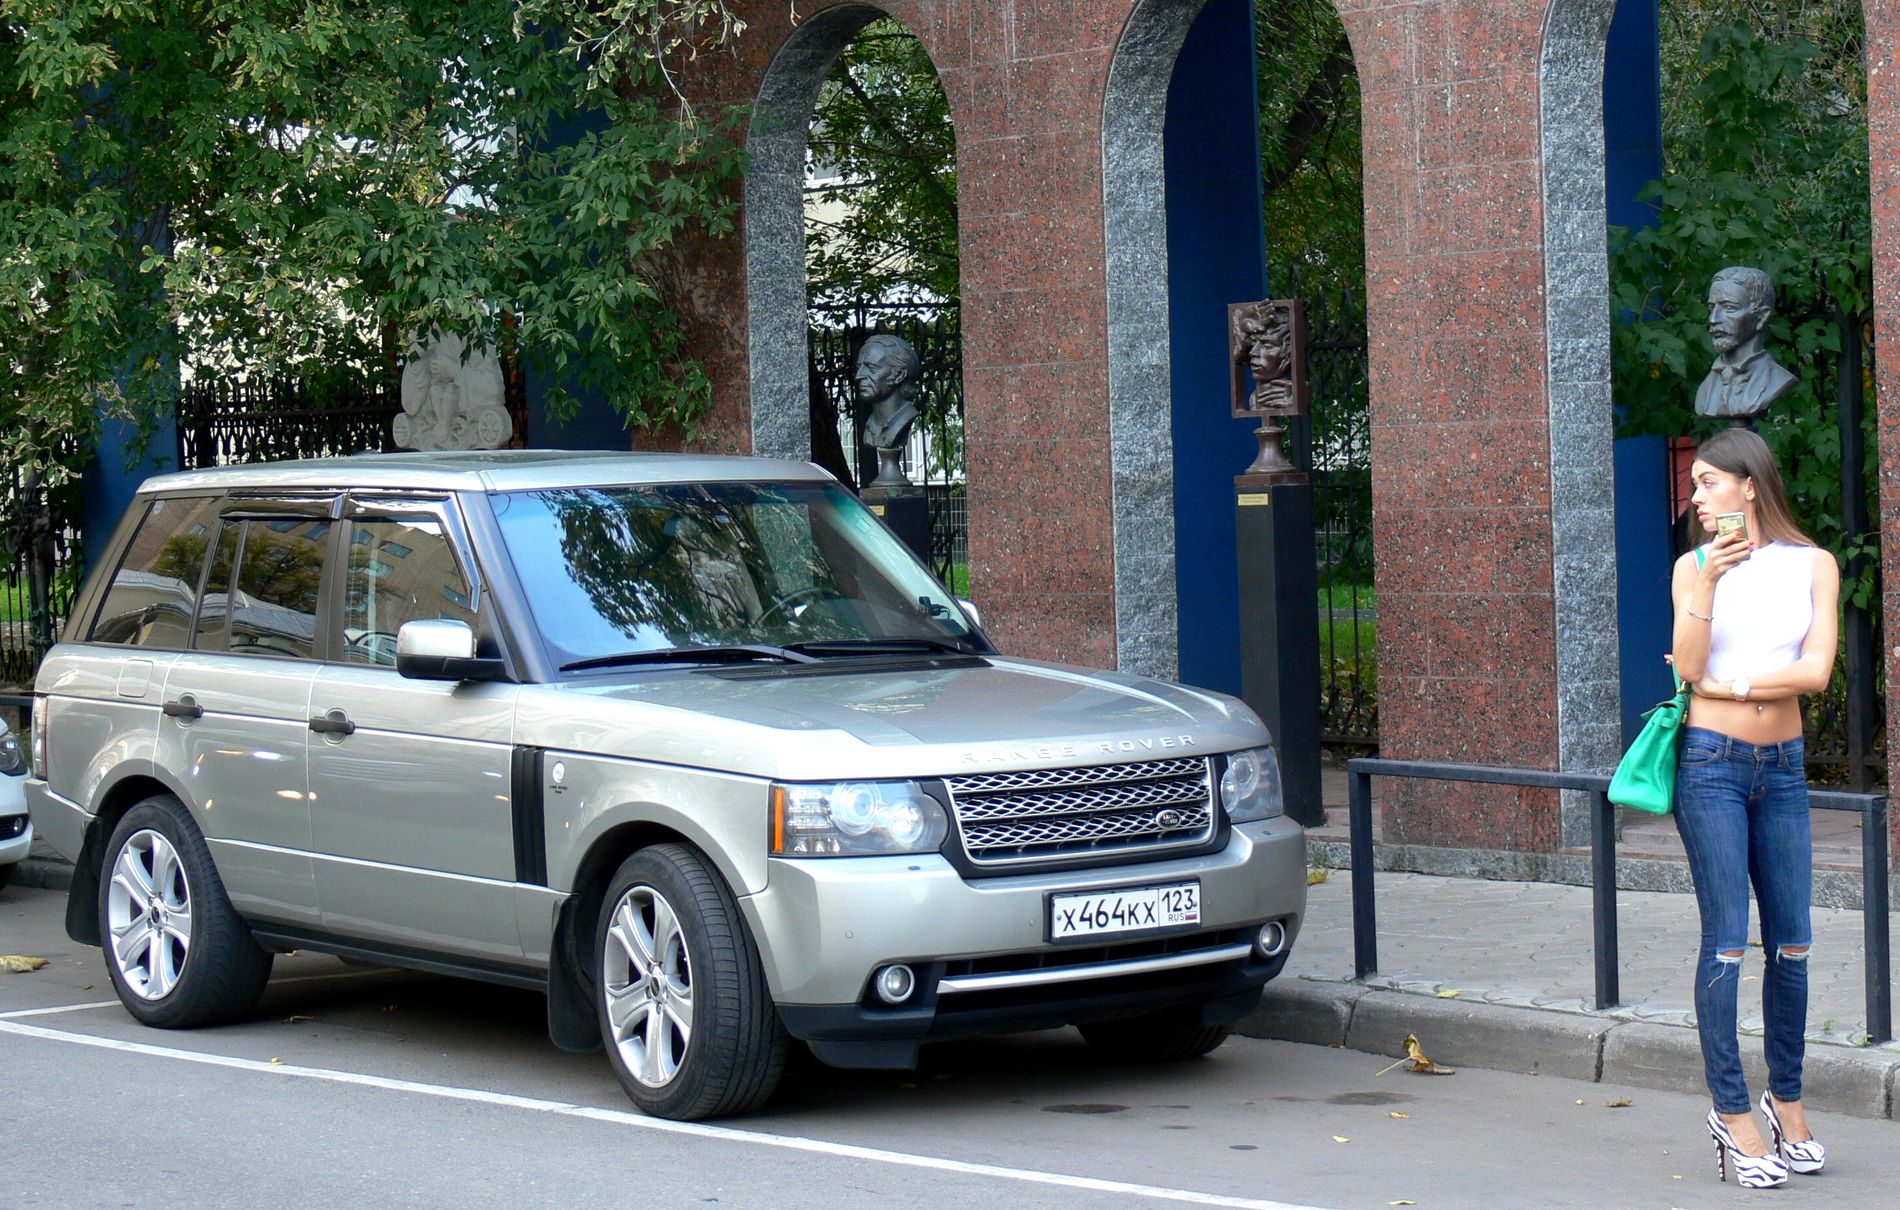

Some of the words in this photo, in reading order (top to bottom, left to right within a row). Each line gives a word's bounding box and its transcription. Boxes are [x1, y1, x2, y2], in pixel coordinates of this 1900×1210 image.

[959, 744, 1077, 764] RANGE
[1098, 734, 1196, 753] ROVER
[1162, 888, 1194, 913] 123
[1168, 911, 1185, 922] RUS
